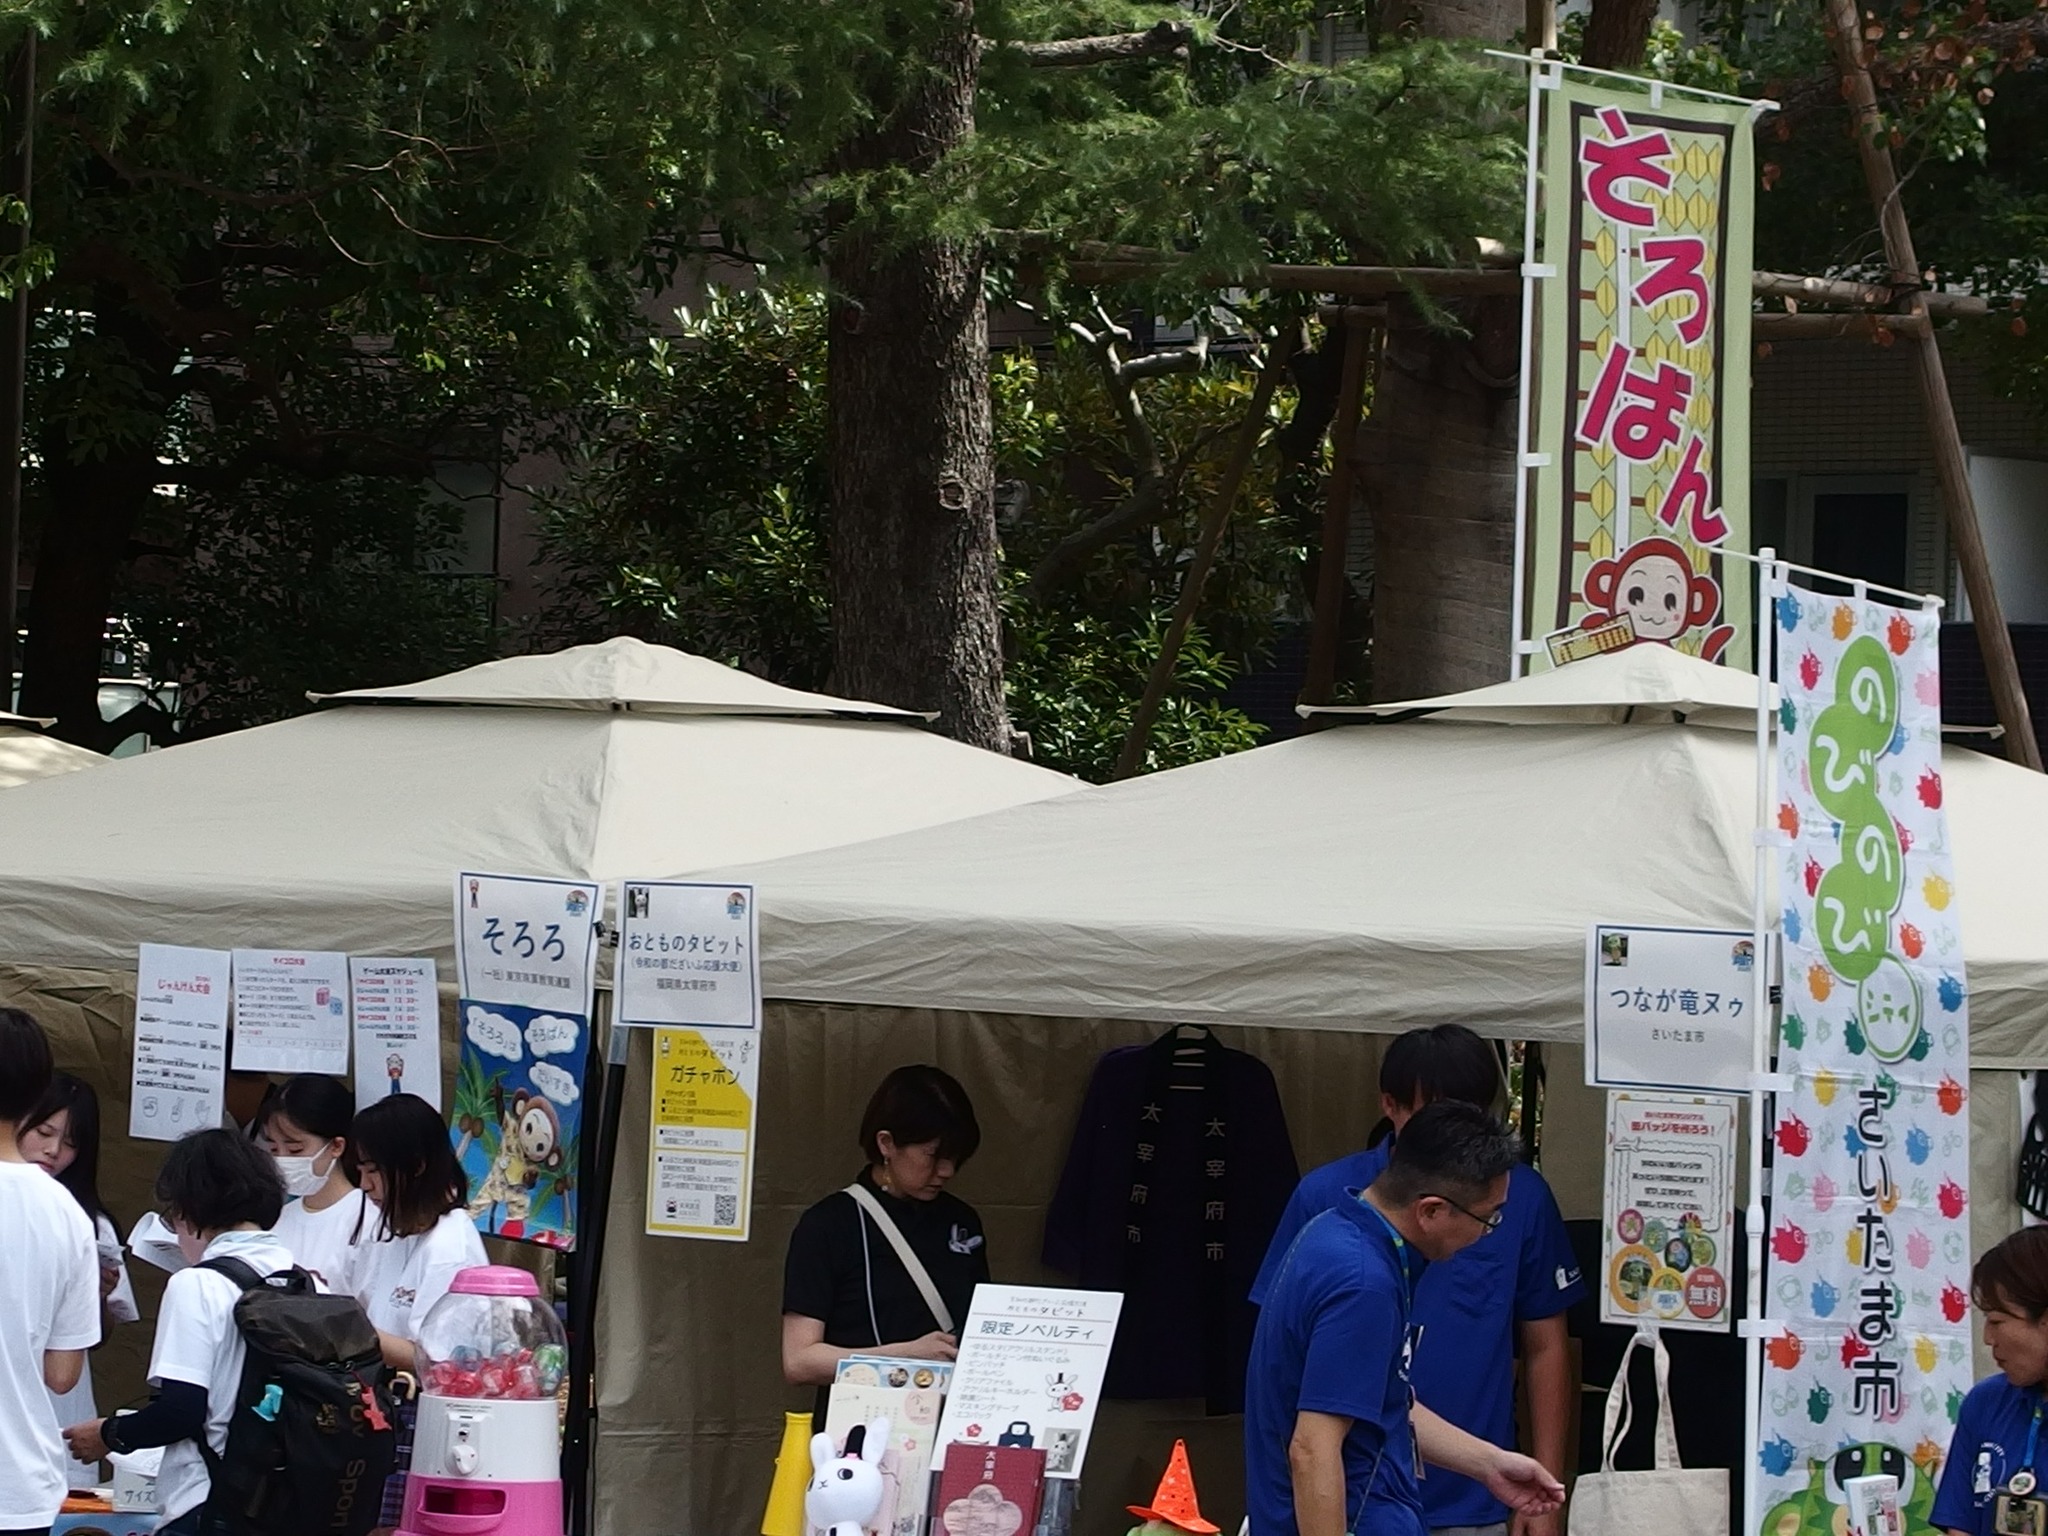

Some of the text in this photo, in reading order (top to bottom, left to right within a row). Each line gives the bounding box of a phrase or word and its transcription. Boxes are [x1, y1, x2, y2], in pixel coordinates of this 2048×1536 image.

[1579, 107, 1731, 546] そろばん
[1816, 666, 1892, 955] のびのび
[482, 917, 565, 962] そろろ
[629, 932, 744, 955] おとものタビット
[656, 978, 718, 991] 福岡県太宰府市
[1611, 986, 1743, 1018] つなが竜ヌゥ
[1652, 1029, 1705, 1043] さいたま市
[1126, 1102, 1162, 1243] 太宰府市
[1205, 1117, 1226, 1261] 太宰府市
[1853, 1084, 1898, 1420] さいたま市
[1689, 1285, 1720, 1307] 無料
[980, 1320, 1095, 1340] 限定ノベルティ
